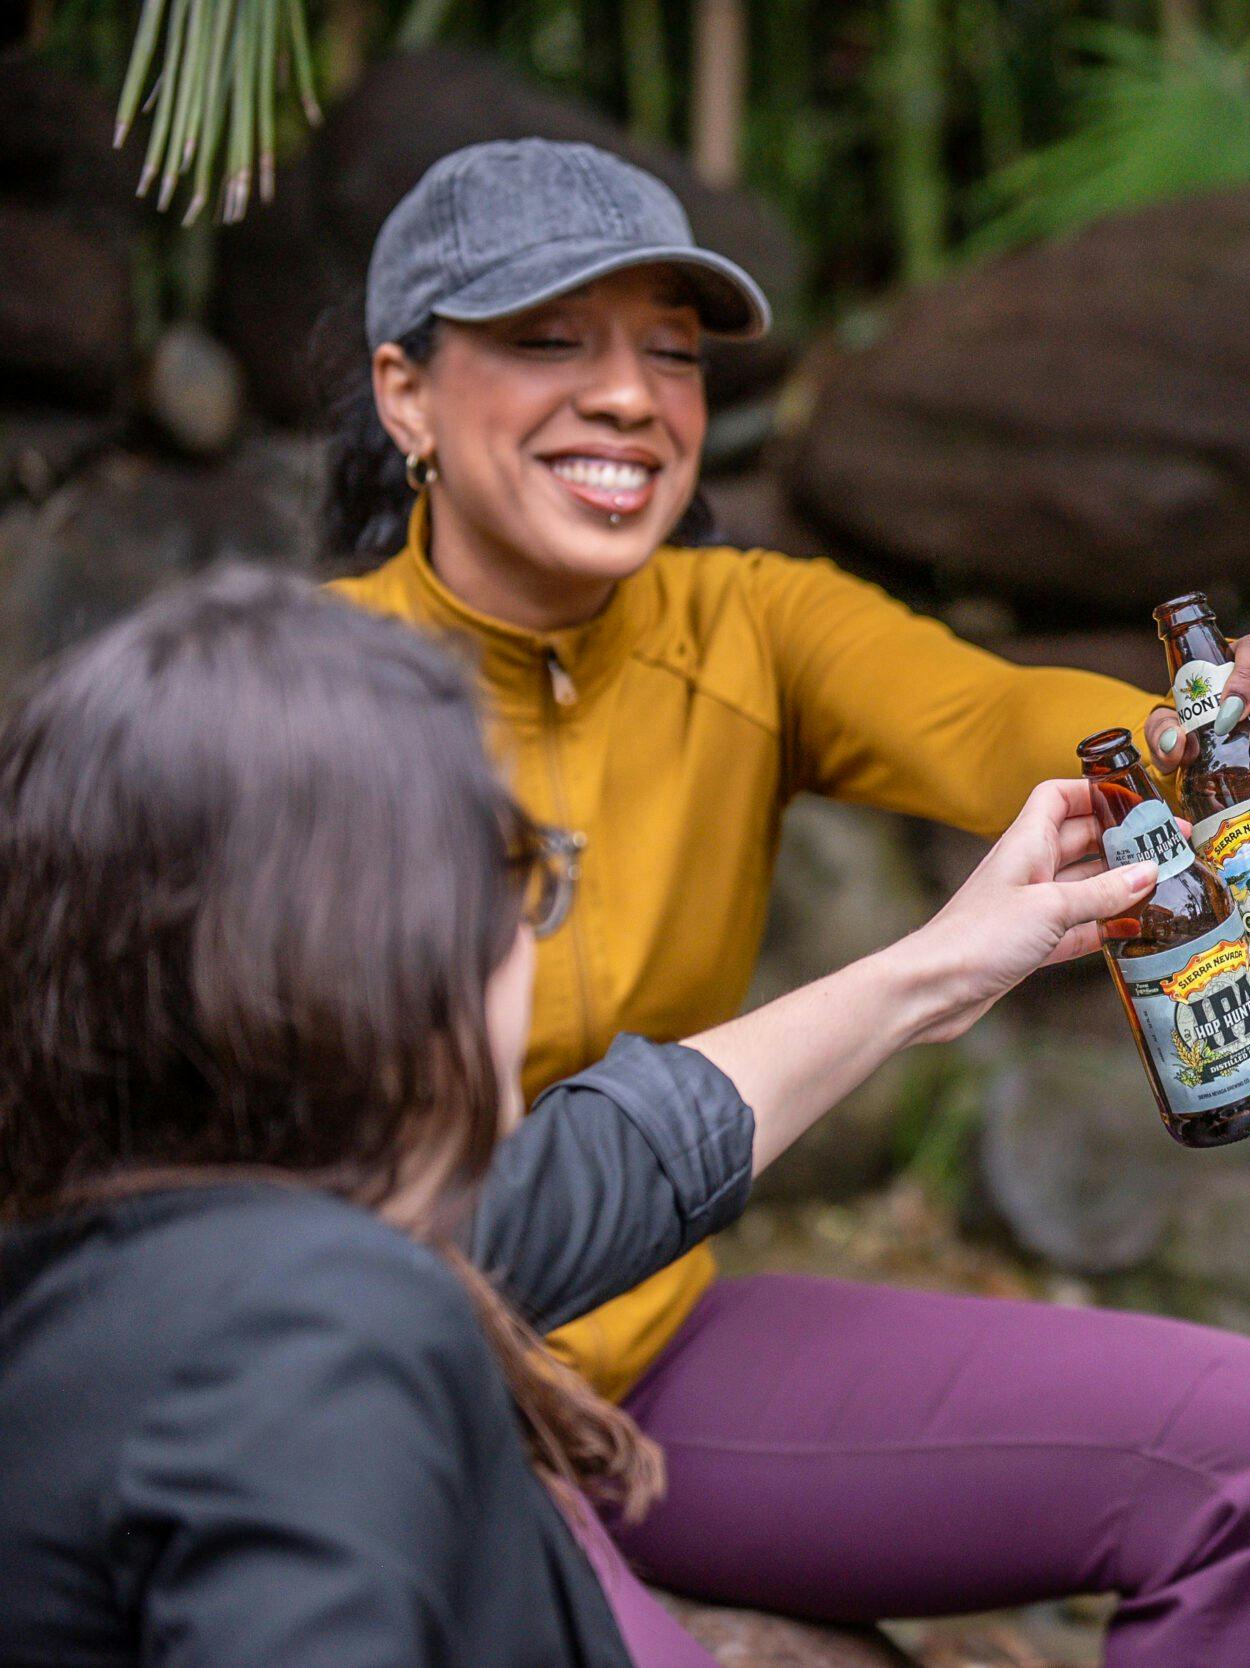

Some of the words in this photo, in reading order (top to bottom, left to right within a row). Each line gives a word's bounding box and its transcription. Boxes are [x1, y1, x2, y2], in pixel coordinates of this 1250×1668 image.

[1178, 692, 1222, 725] NOONE
[1133, 819, 1186, 866] IPA
[1214, 828, 1243, 855] SIERRA
[1137, 849, 1156, 862] HOP
[1178, 962, 1213, 990] SIERRA
[1213, 950, 1243, 967] NEVADA
[1194, 1018, 1221, 1040] HOP
[1210, 1053, 1249, 1074] DISTILLED
